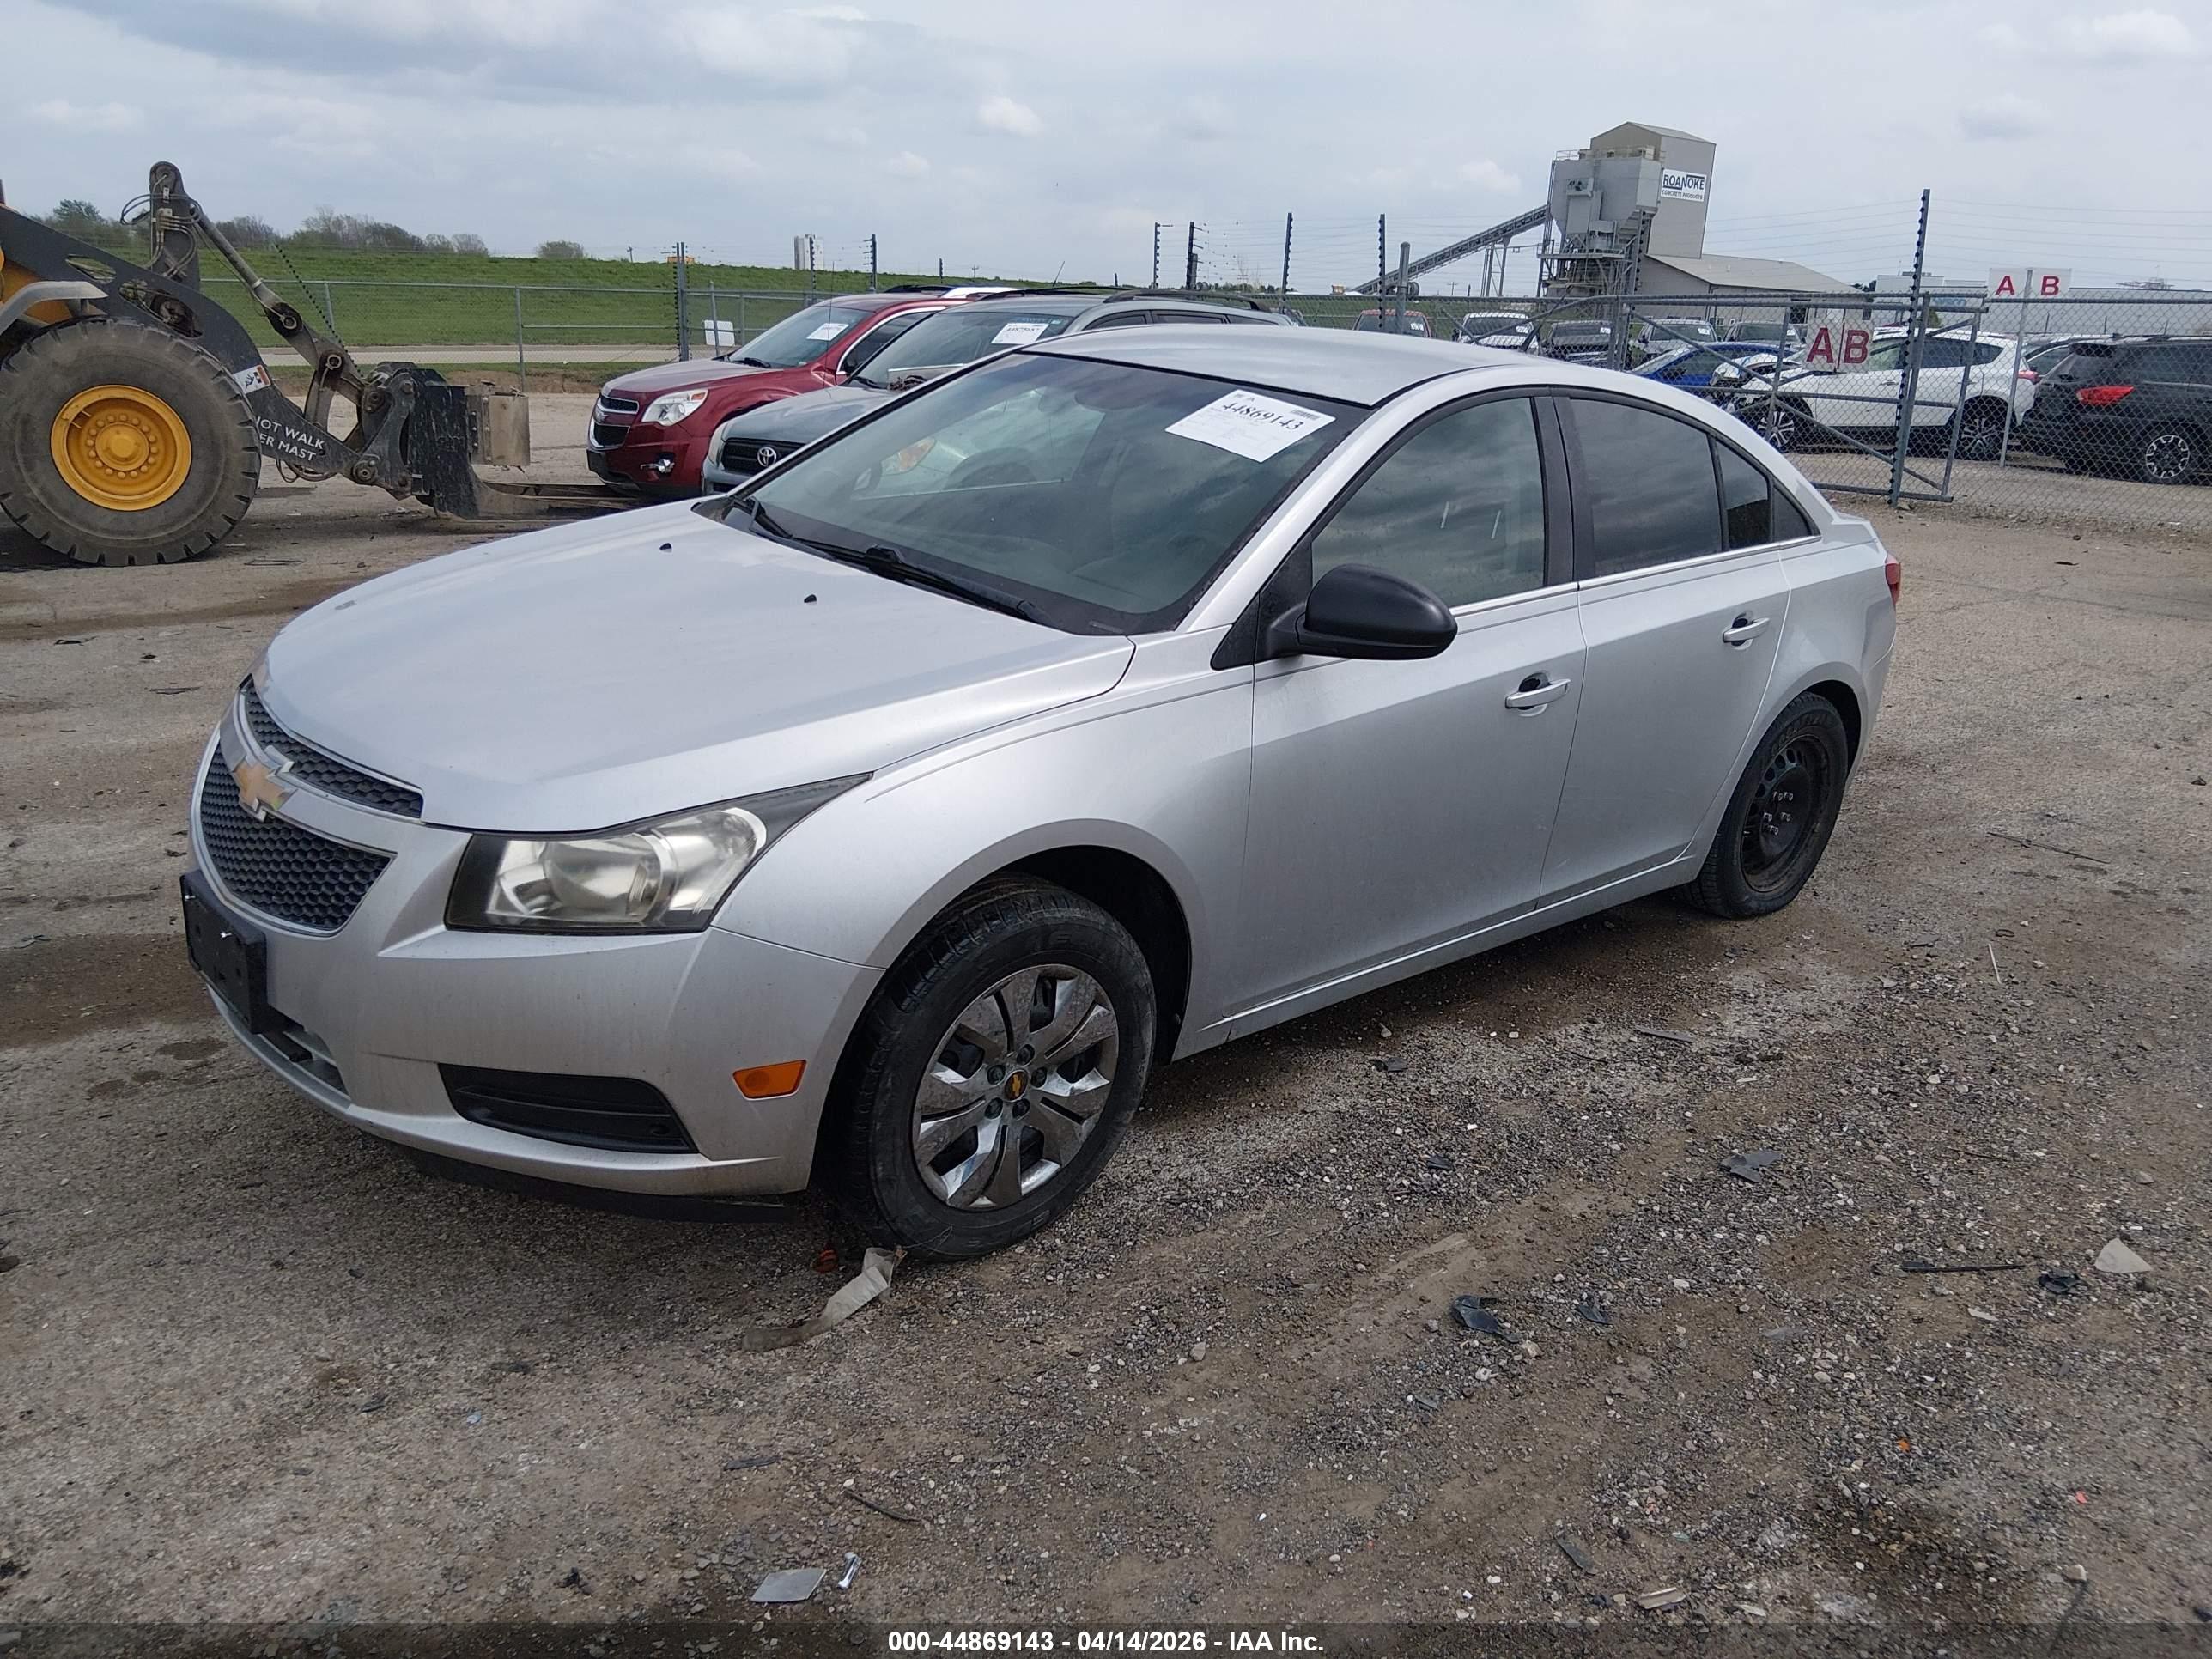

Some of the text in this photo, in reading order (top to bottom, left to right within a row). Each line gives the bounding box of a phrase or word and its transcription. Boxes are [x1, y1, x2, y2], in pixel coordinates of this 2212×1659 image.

[1663, 174, 1705, 190] ROANOKE
[1996, 275, 2060, 296] A B
[1806, 327, 1870, 364] A B
[1222, 402, 1304, 430] 44869143
[285, 427, 325, 449] WALK
[277, 441, 317, 461] MAST
